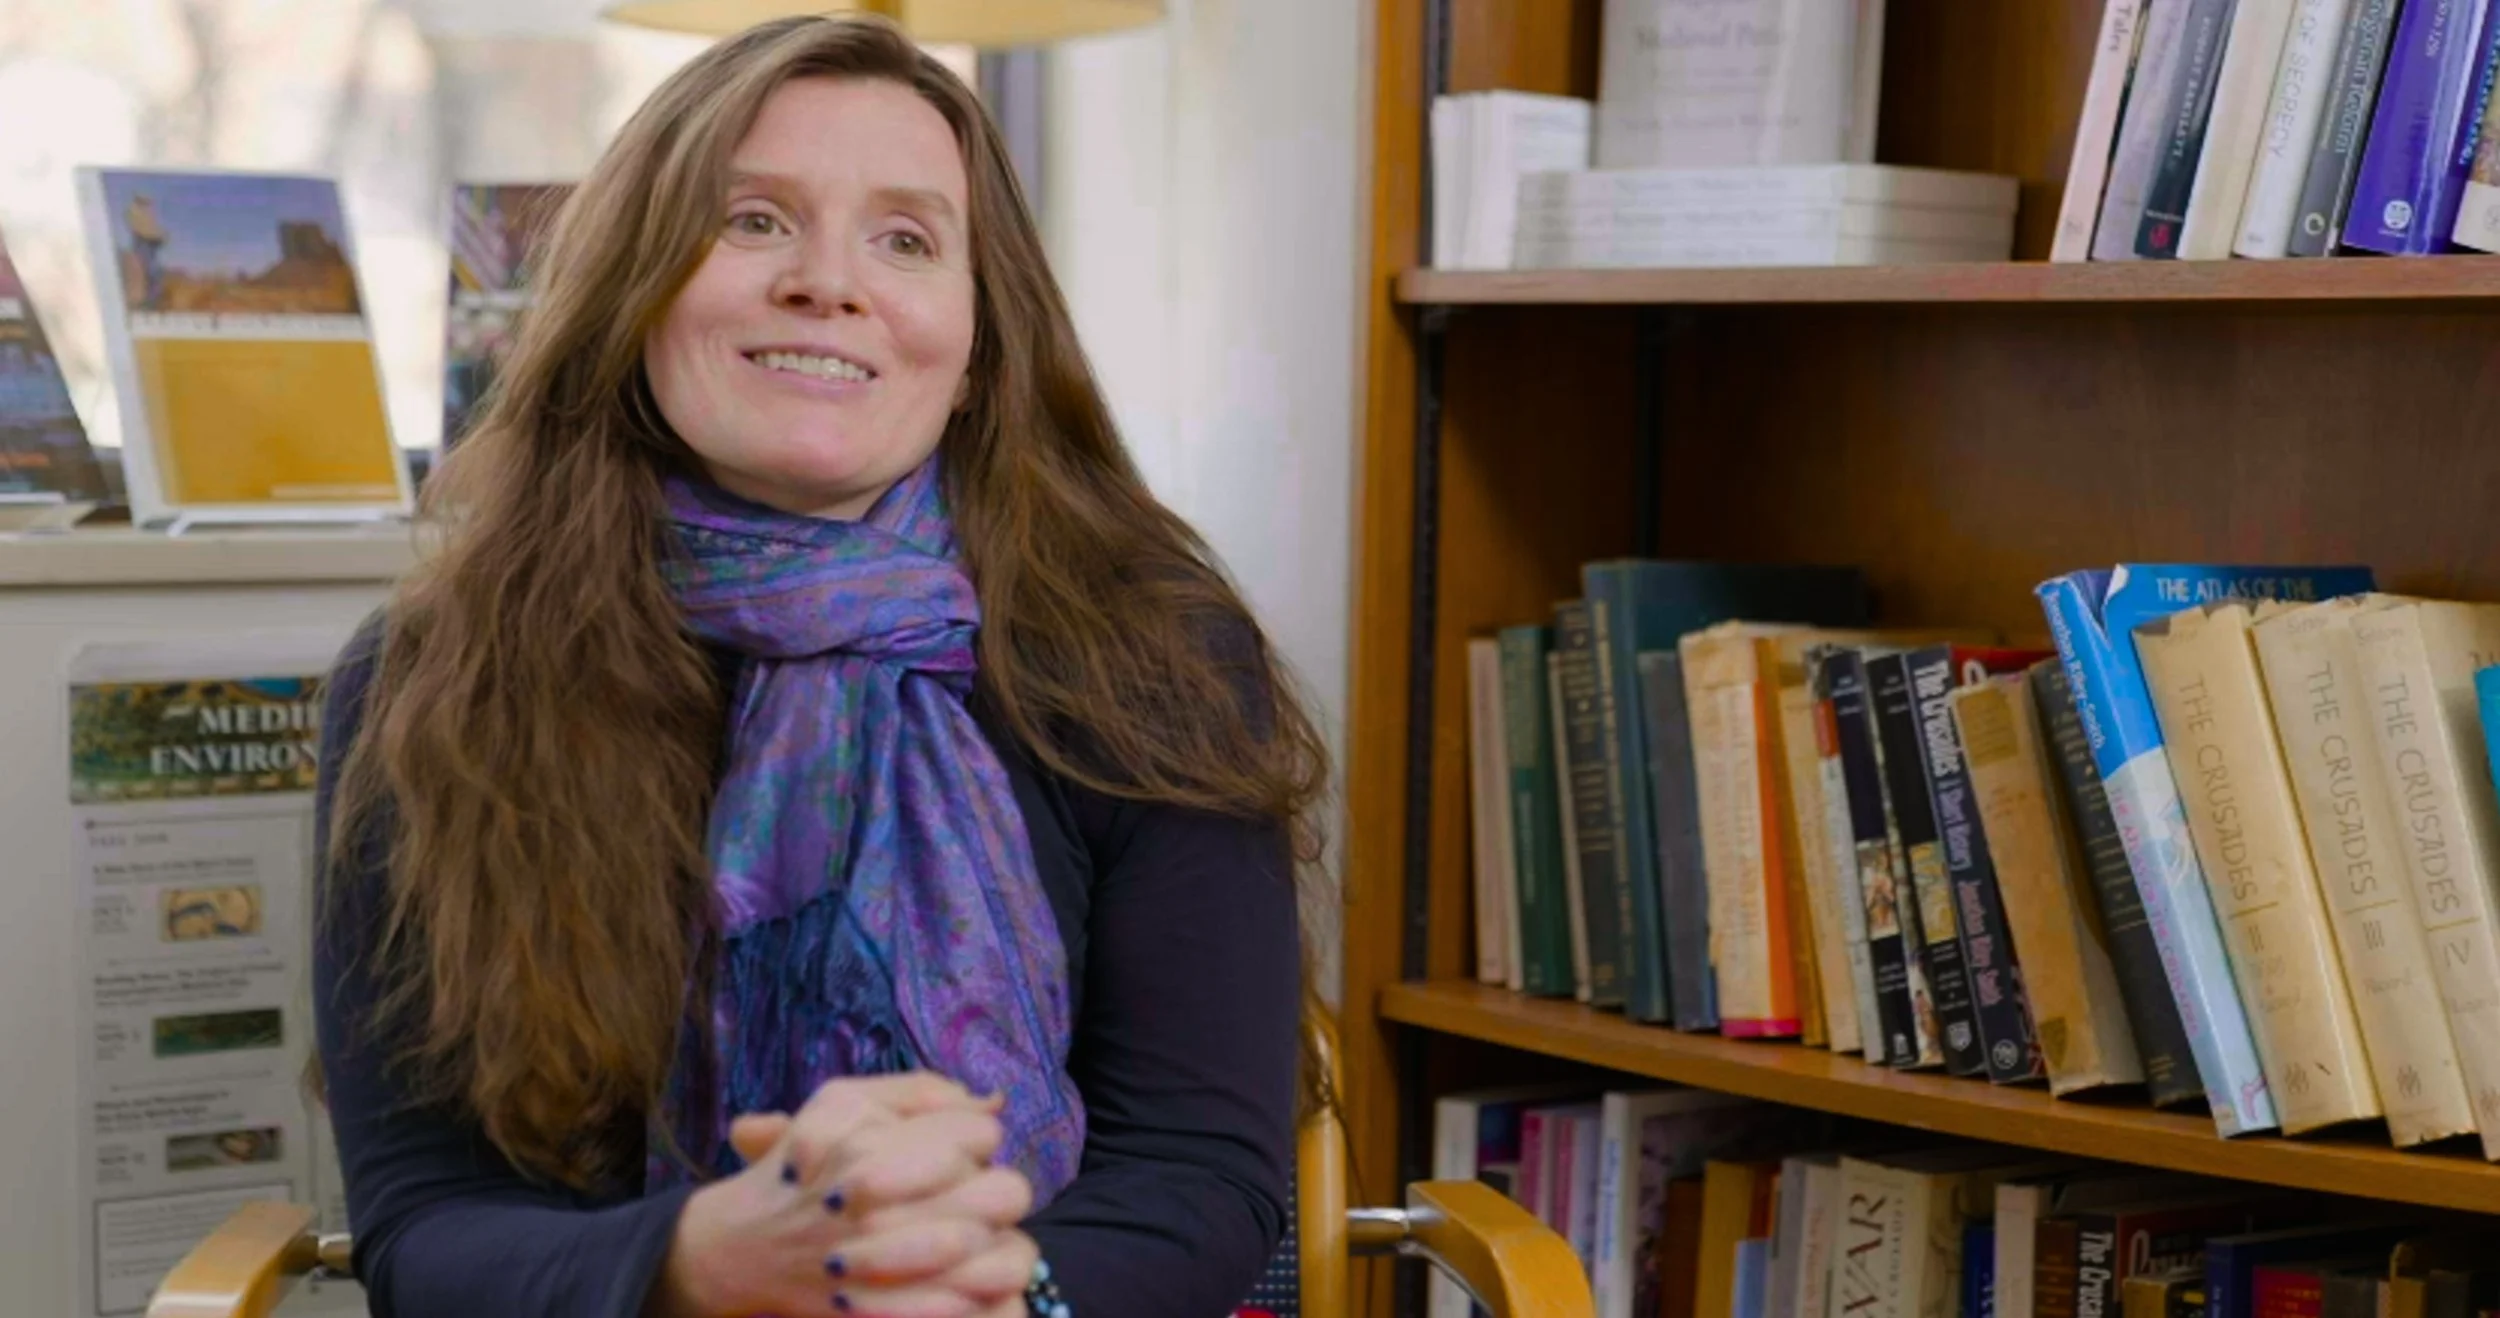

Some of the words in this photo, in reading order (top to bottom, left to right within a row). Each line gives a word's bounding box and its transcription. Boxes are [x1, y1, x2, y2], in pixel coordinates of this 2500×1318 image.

[2267, 52, 2310, 159] SECRECY
[2156, 577, 2190, 602] THE
[2194, 577, 2250, 602] ATLAS
[1913, 659, 1950, 700] The
[2306, 660, 2342, 725] THE
[2377, 672, 2419, 739] THE
[1920, 697, 1962, 778] Crusades
[2180, 680, 2214, 734] THE
[2197, 744, 2258, 901] CRUSADES
[2320, 734, 2378, 896] CRUSADES
[2396, 749, 2461, 914] CRUSADES
[2079, 1230, 2115, 1264] The
[2076, 1265, 2112, 1318] Crusa
